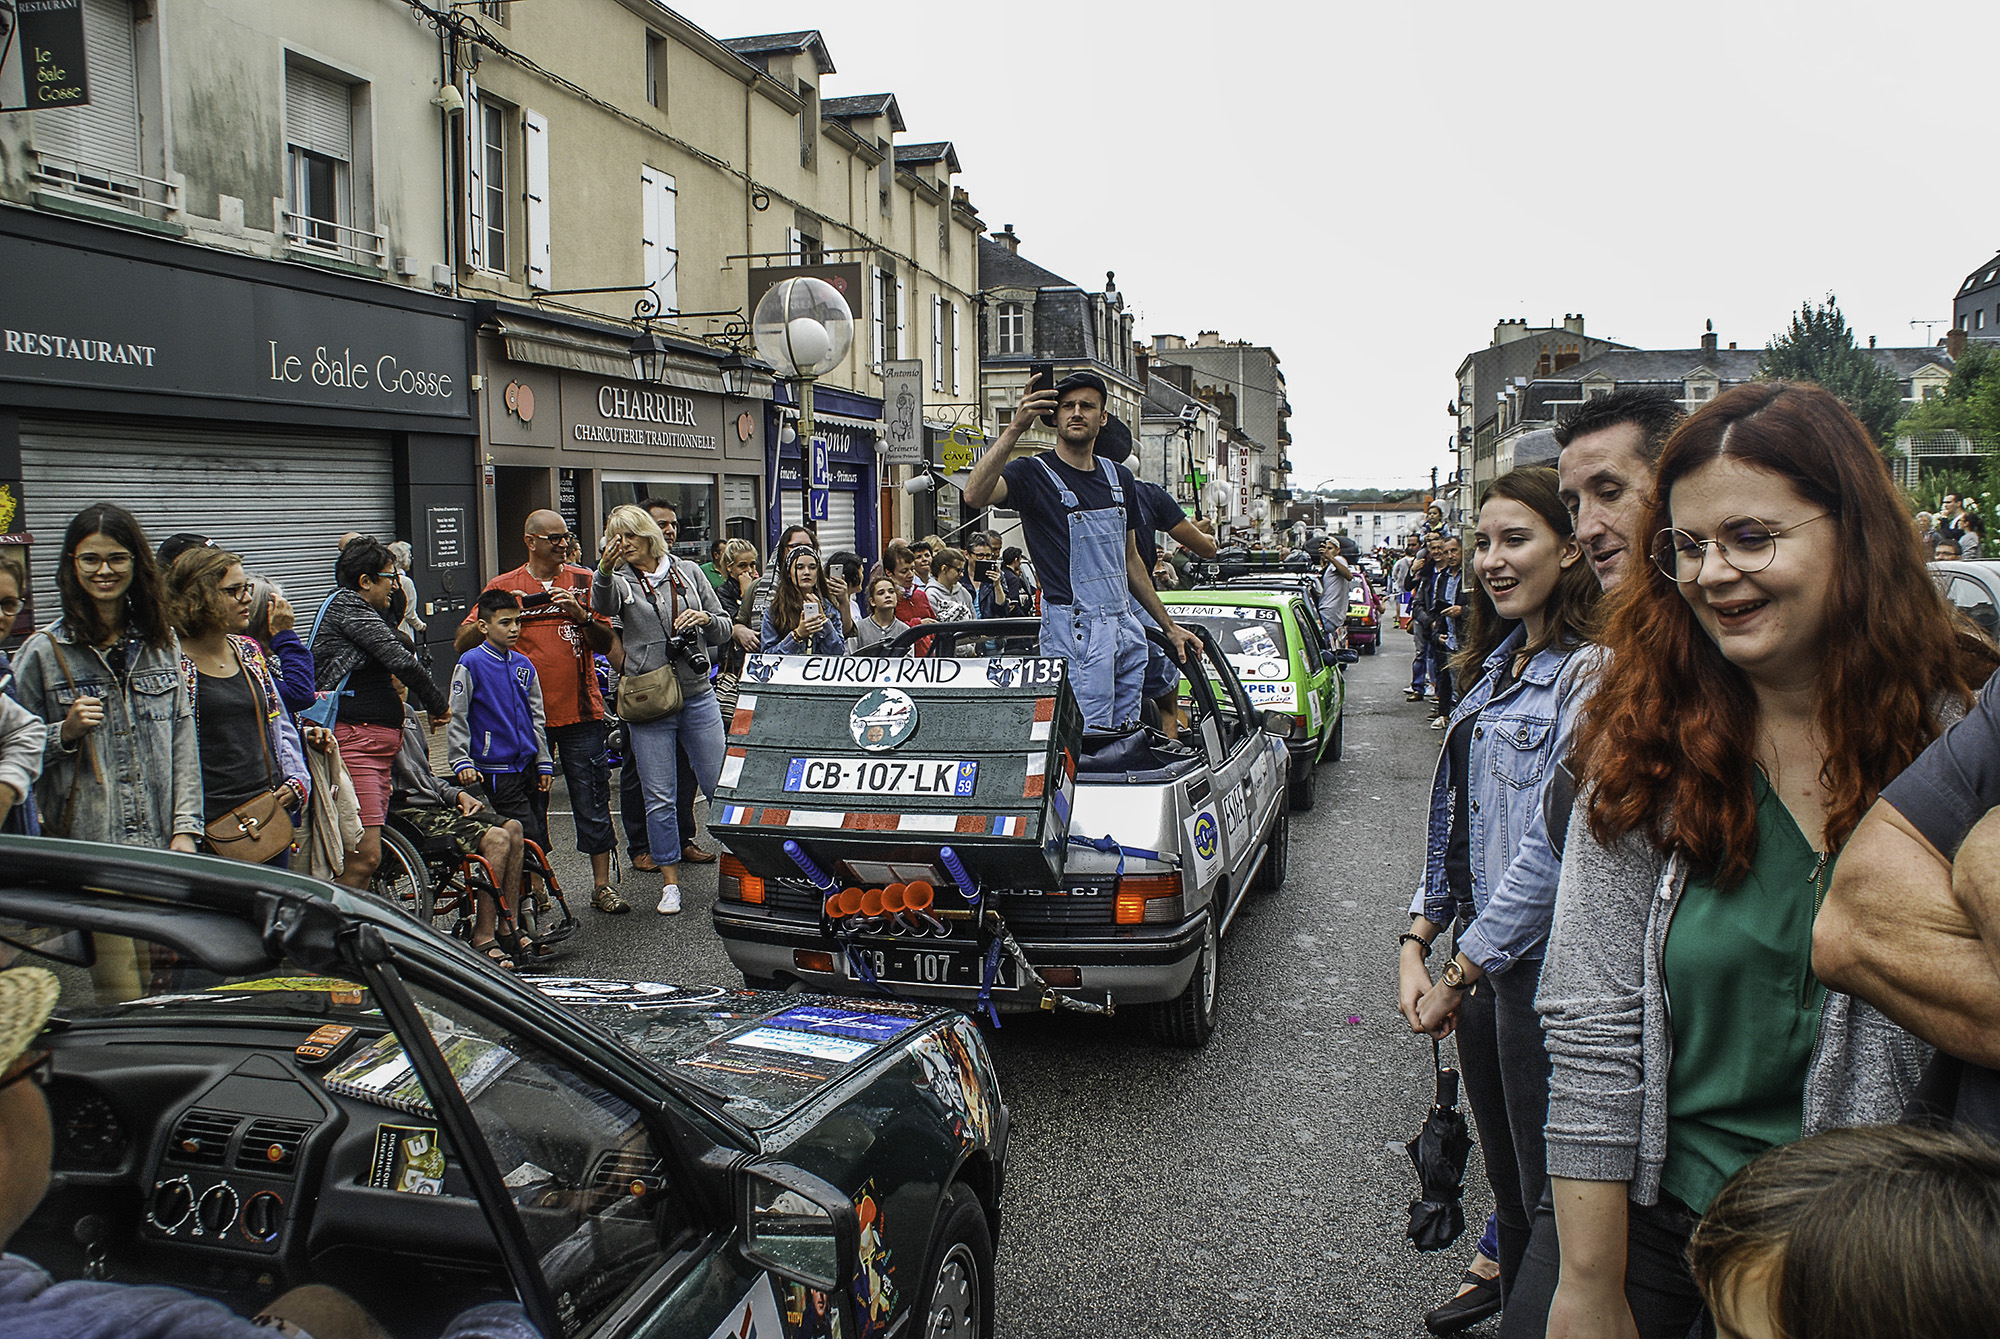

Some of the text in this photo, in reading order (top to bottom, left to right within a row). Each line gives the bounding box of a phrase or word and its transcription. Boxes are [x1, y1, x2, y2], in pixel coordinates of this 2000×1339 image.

[19, 0, 79, 12] RESTAURANT
[35, 47, 52, 62] Le
[37, 65, 67, 82] Sale
[38, 85, 82, 101] Gosse
[4, 329, 156, 367] RESTAURANT
[268, 340, 453, 398] Le Sale Gosse
[885, 368, 920, 378] Antonio
[598, 385, 697, 427] CHARRIER
[574, 423, 716, 450] CHARCUTERIE TRADITIONNELLE
[816, 447, 825, 478] P
[943, 452, 972, 460] CAVE
[1239, 448, 1249, 516] MUSIQUE
[0, 535, 23, 543] ENU
[1259, 611, 1273, 620] 56
[1023, 659, 1063, 684] 135
[788, 777, 797, 787] F
[957, 779, 973, 794] 59
[1071, 887, 1099, 896] CJ
[913, 953, 950, 982] 107
